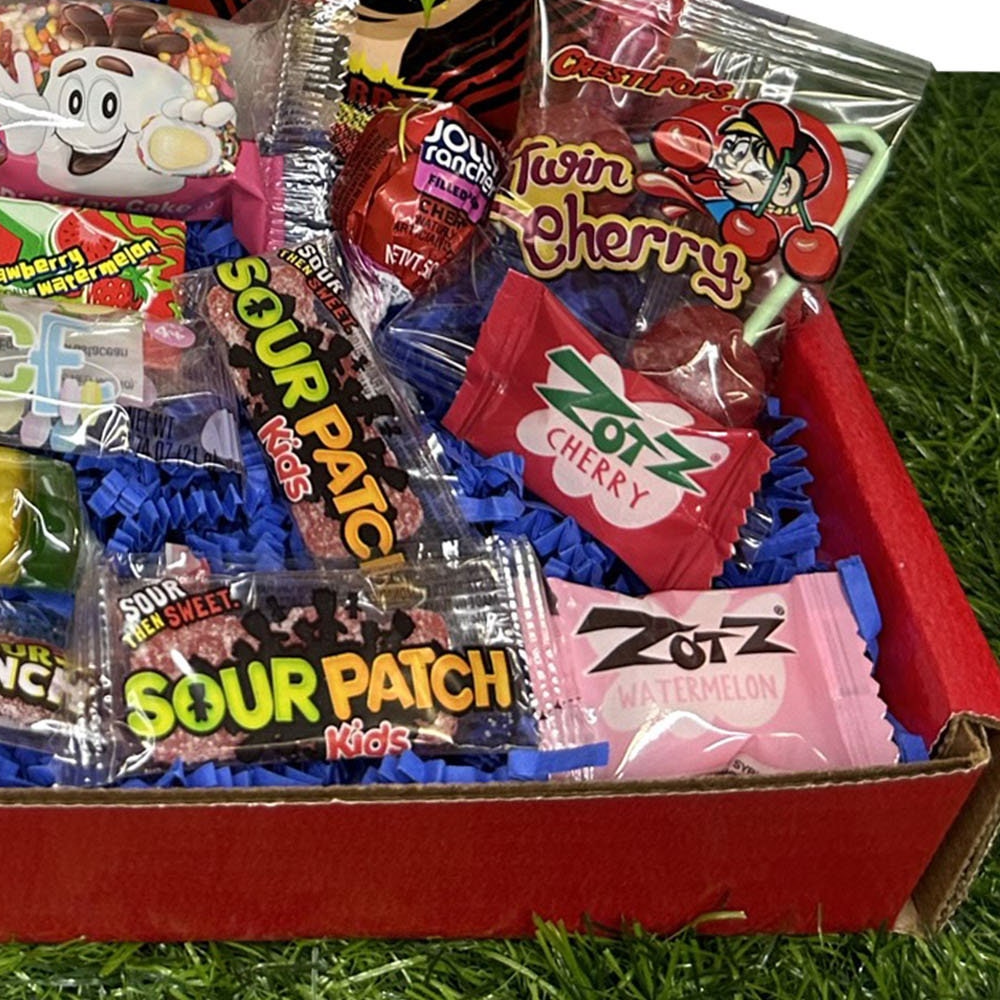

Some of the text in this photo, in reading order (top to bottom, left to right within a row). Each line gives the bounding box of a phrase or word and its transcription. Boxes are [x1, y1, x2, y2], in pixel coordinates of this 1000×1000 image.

[424, 119, 499, 177] JOLLY
[514, 141, 628, 196] Twin
[279, 249, 313, 277] THEN
[298, 243, 344, 294] SOUR
[531, 194, 749, 301] Cherry
[217, 257, 330, 409] SOUR
[533, 345, 712, 496] ZOTZ
[257, 415, 313, 502] Kids
[547, 428, 651, 509] CHERRY
[119, 579, 187, 622] SOUR
[121, 611, 166, 649] THEN
[577, 606, 796, 674] ZOTZ
[124, 647, 513, 740] SOUR PATCH
[617, 674, 779, 710] WATERMELON
[323, 717, 412, 760] Kids
